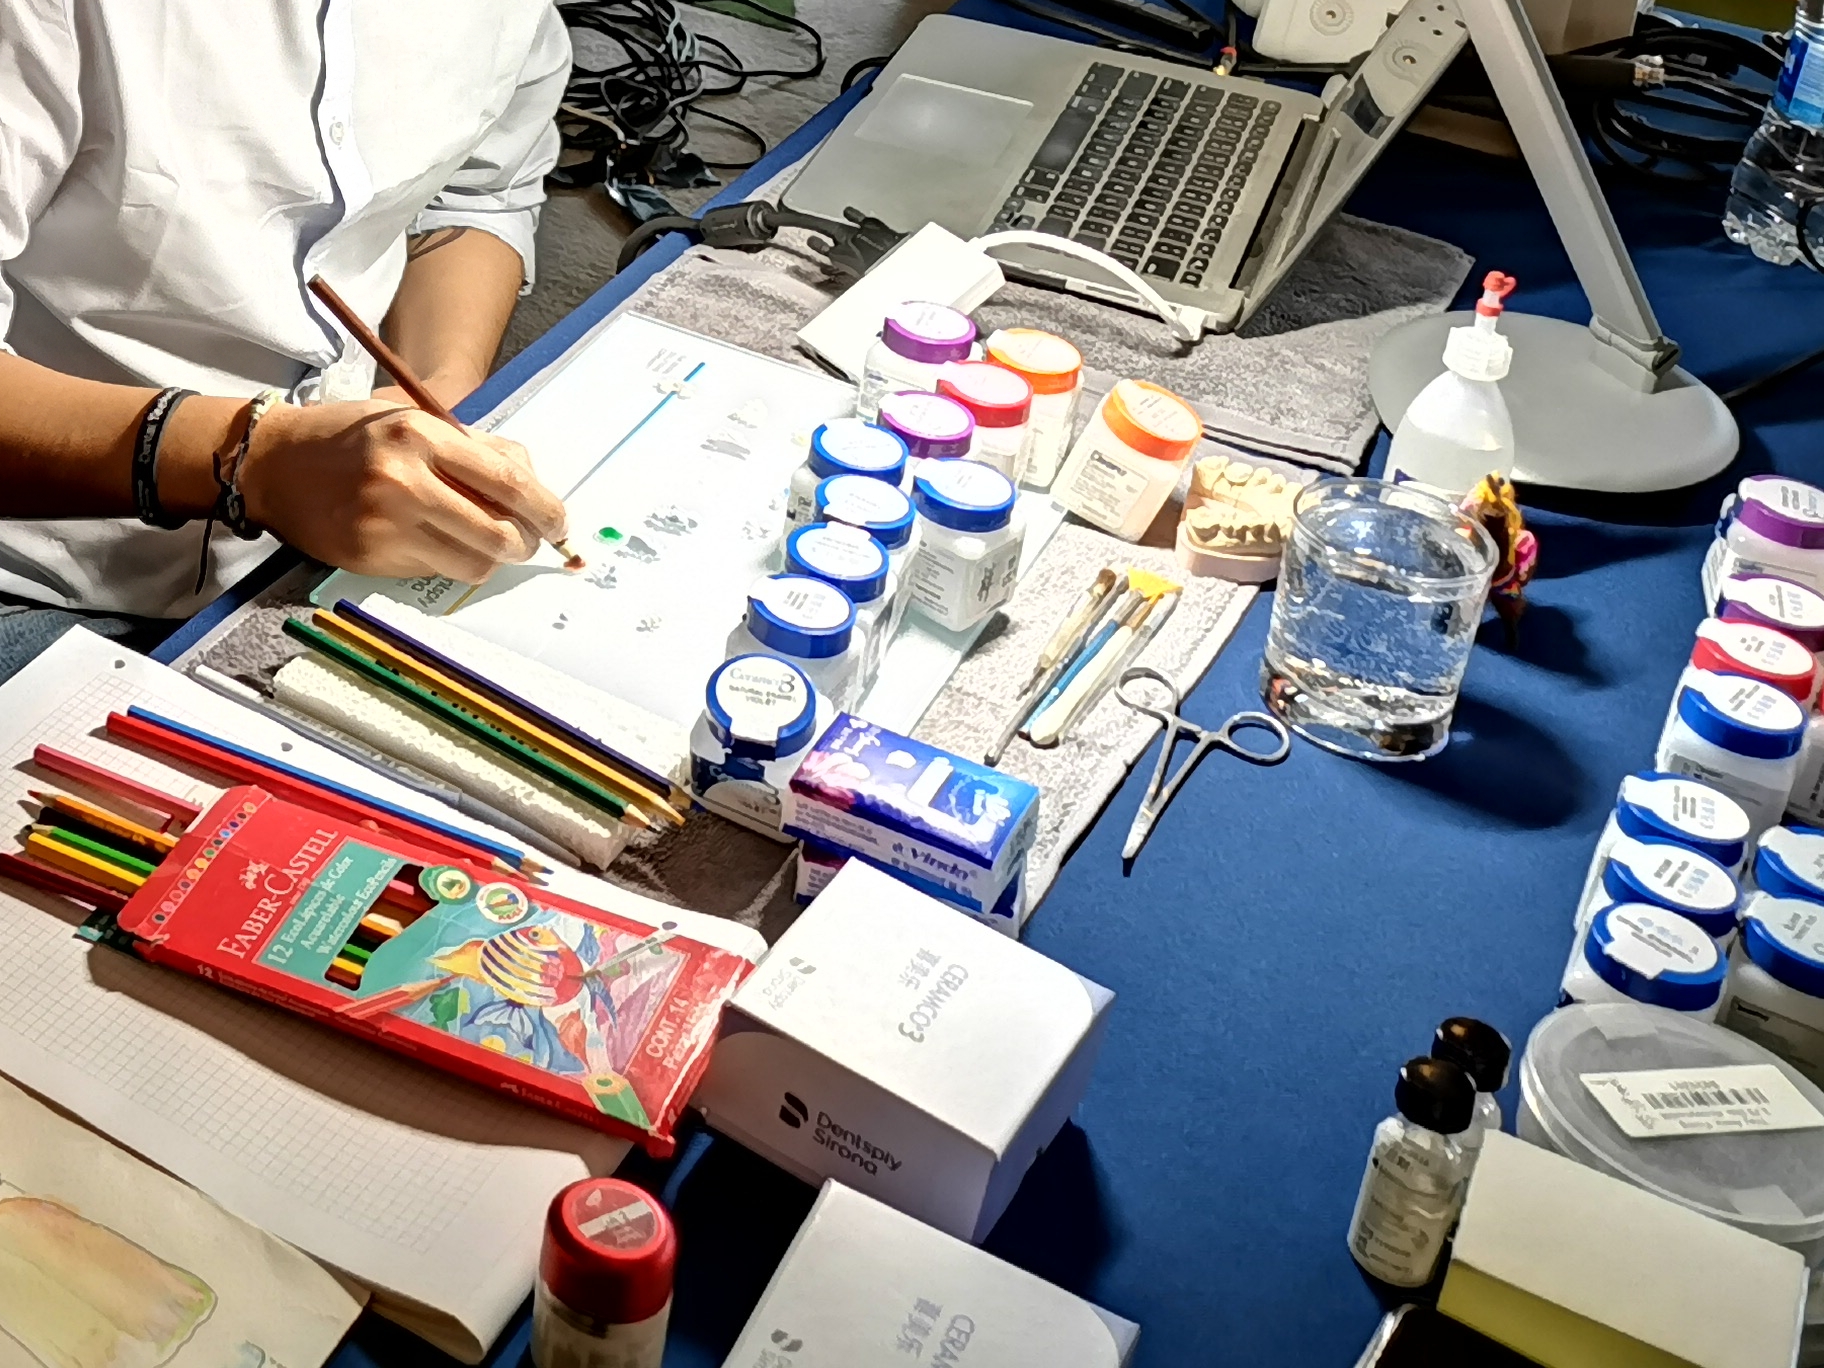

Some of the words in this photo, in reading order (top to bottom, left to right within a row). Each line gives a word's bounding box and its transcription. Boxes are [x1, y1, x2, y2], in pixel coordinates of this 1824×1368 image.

[217, 827, 339, 959] FABER-CASTELL
[268, 943, 294, 965] 12
[329, 856, 354, 880] Color
[813, 1128, 880, 1175] Sirona
[816, 1111, 902, 1171] Dentsply
